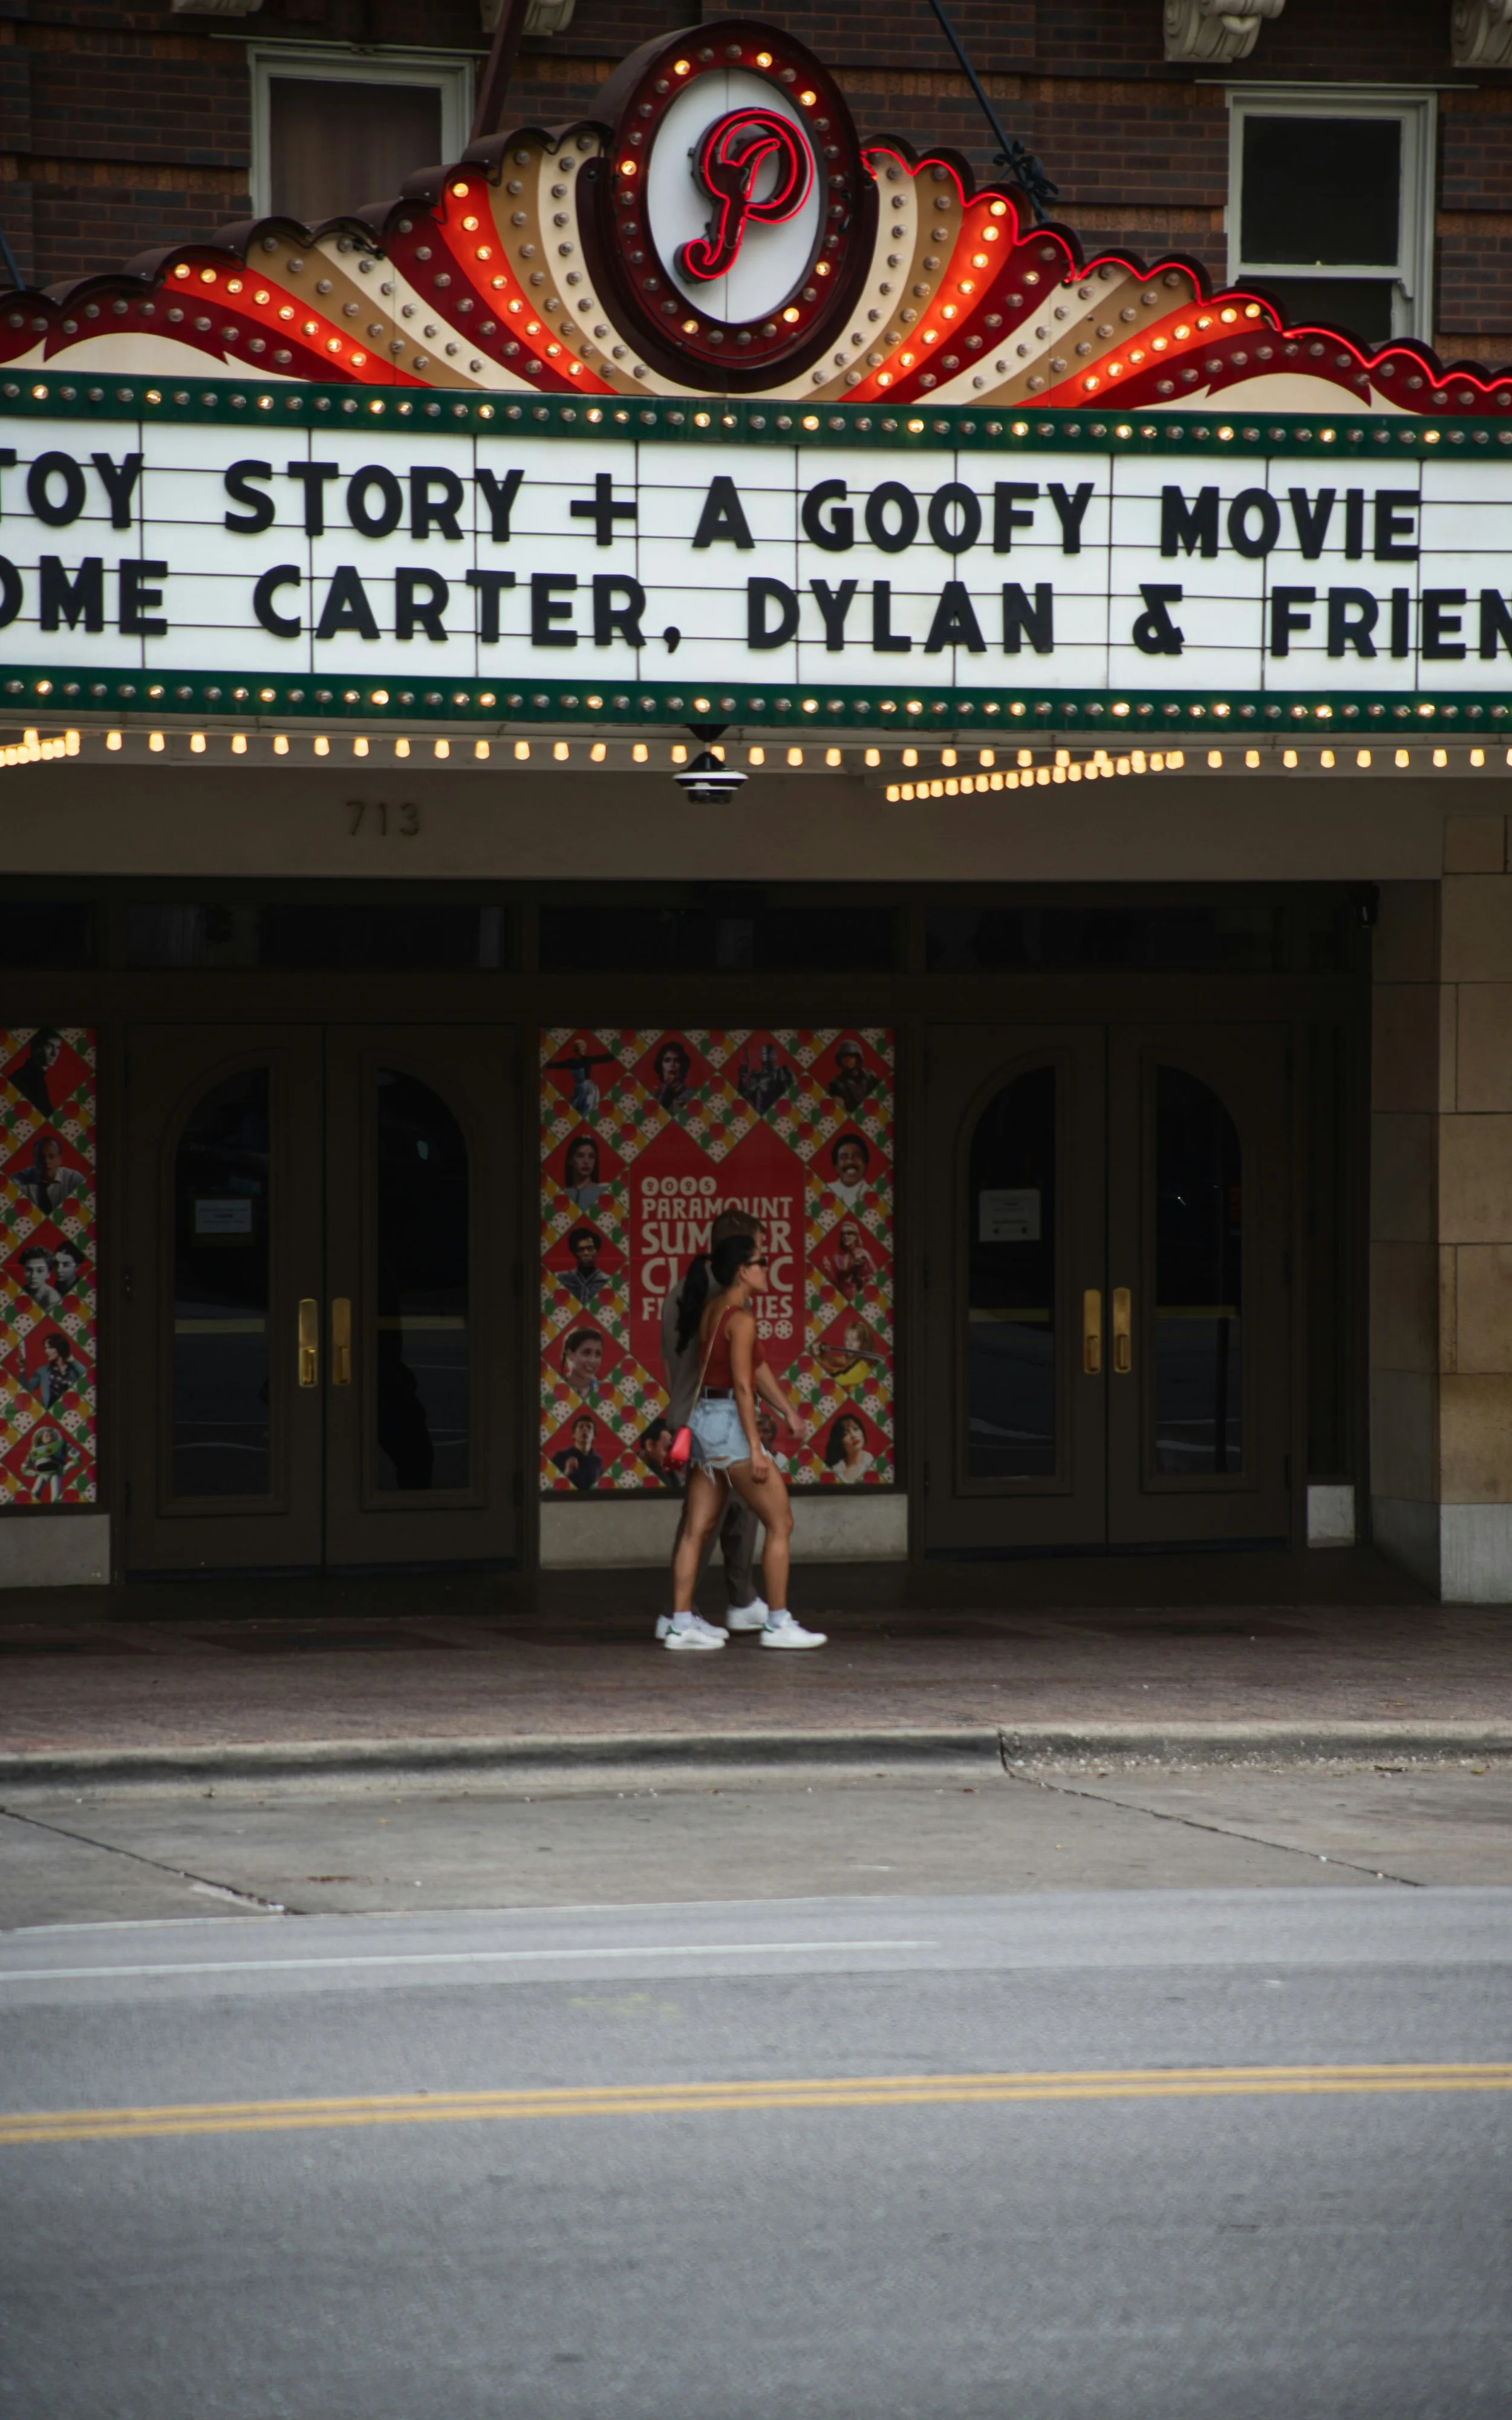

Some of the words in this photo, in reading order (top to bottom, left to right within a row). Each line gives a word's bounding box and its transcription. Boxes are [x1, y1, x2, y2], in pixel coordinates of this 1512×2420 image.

[674, 107, 814, 283] P
[224, 459, 524, 543] STORY
[570, 473, 637, 546] +
[692, 476, 755, 549] A
[802, 479, 1095, 555] GOOFY
[1161, 485, 1420, 561] MOVIE
[253, 564, 681, 653] CARTER,
[748, 577, 1054, 655] DYLAN
[1132, 583, 1185, 655] &
[346, 801, 420, 837] 713
[642, 1177, 715, 1195] 2025
